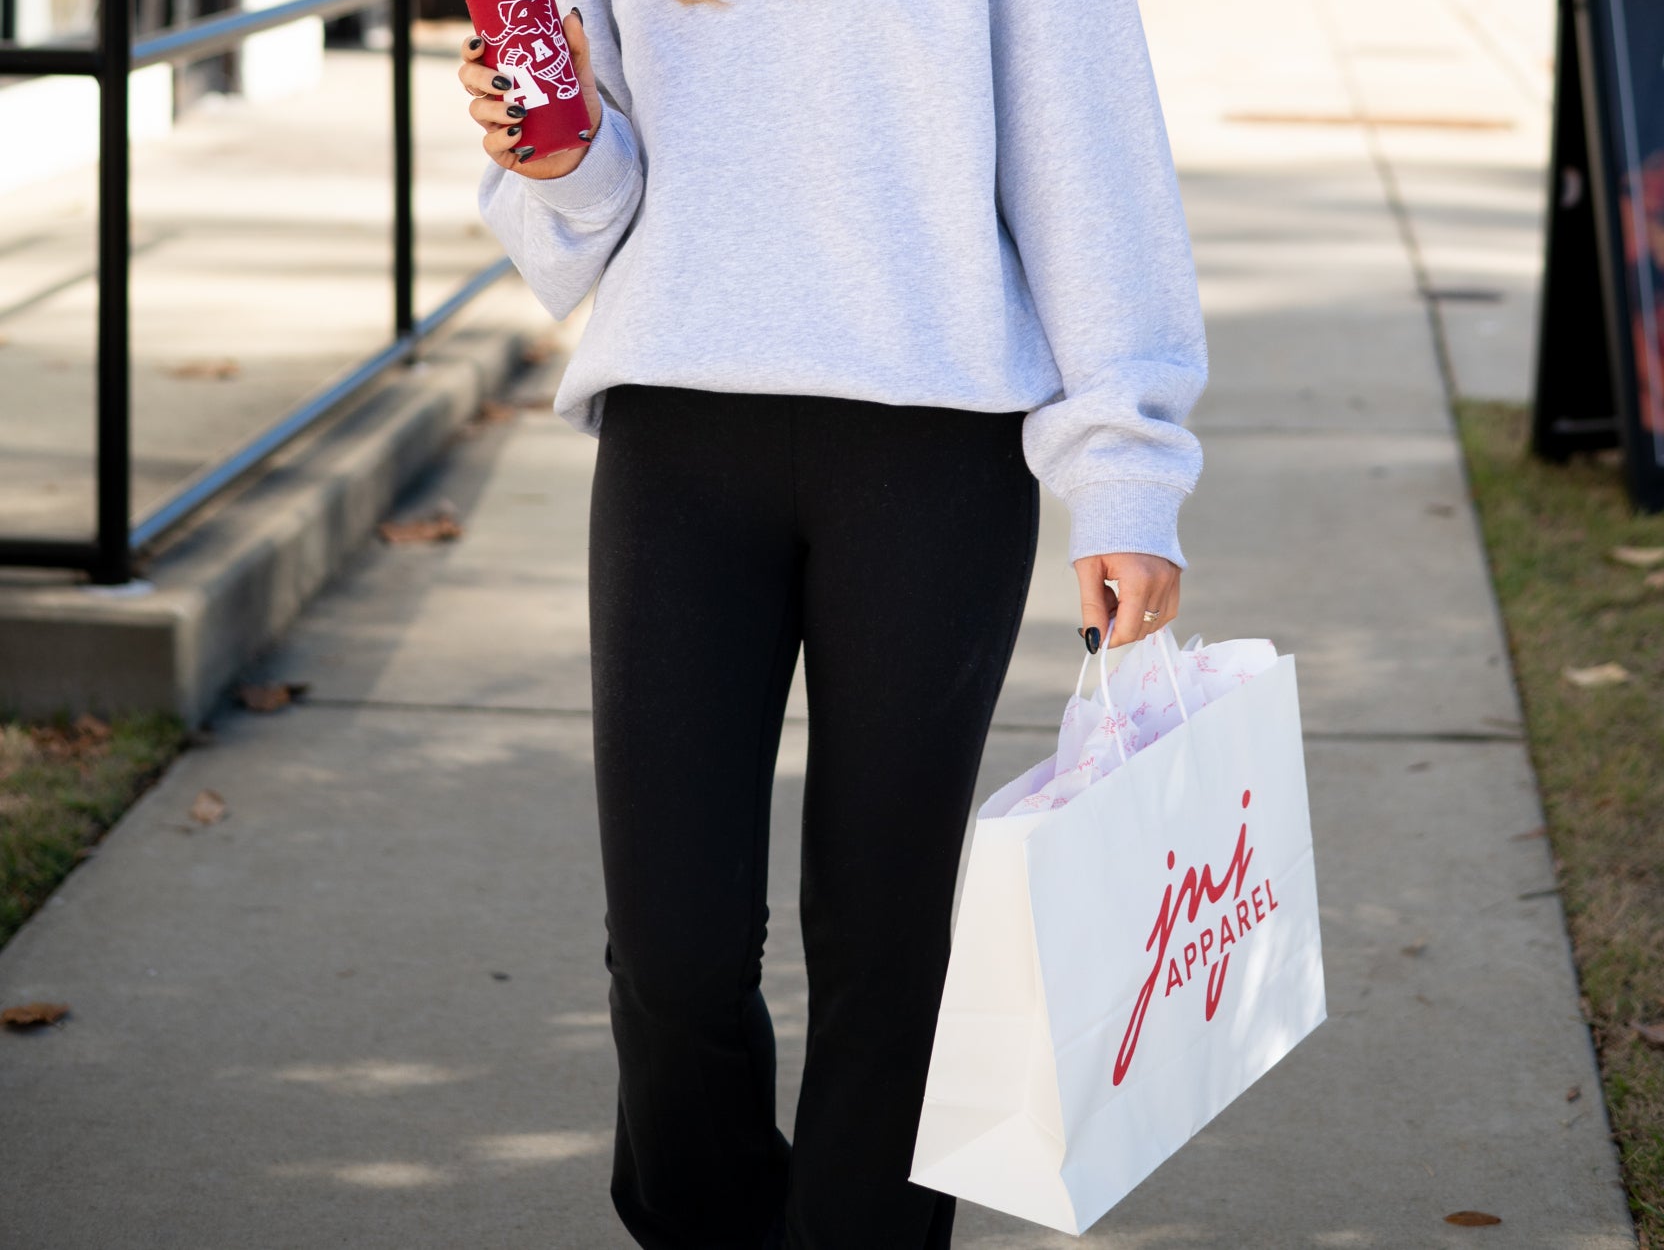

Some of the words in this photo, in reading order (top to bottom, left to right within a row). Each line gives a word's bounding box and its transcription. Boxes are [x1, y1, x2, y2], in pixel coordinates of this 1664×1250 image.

[530, 38, 554, 63] A
[497, 63, 549, 110] A
[1164, 878, 1279, 998] APPAREL
